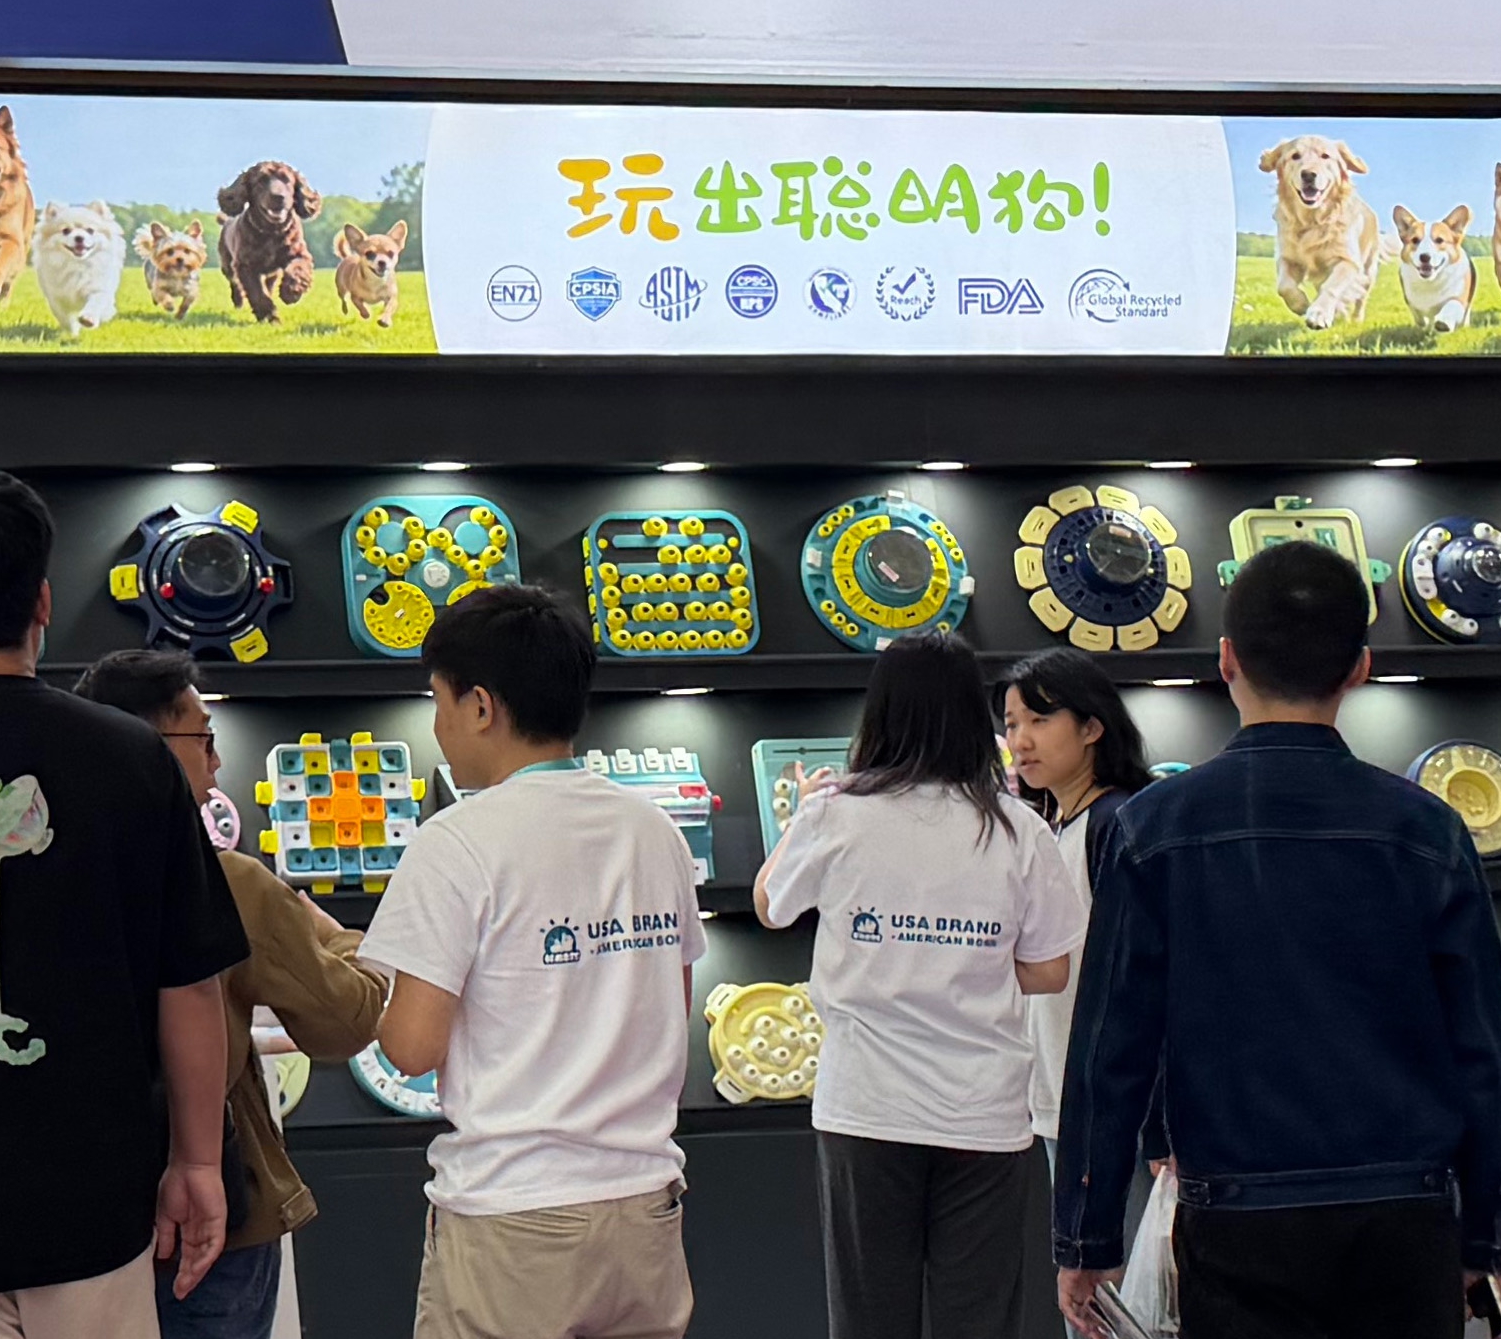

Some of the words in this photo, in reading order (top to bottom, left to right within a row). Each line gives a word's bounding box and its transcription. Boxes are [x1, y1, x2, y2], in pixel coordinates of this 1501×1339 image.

[491, 285, 538, 302] EN71
[570, 282, 618, 298] CPSIA
[645, 266, 703, 322] ASTM
[958, 277, 1045, 315] FDA
[890, 295, 922, 306] Reach
[1088, 294, 1126, 306] Global
[1130, 294, 1182, 307] Recycled
[1115, 307, 1168, 318] Standard
[588, 918, 624, 939] USA
[891, 915, 929, 930] USA
[936, 917, 1001, 936] BRAND
